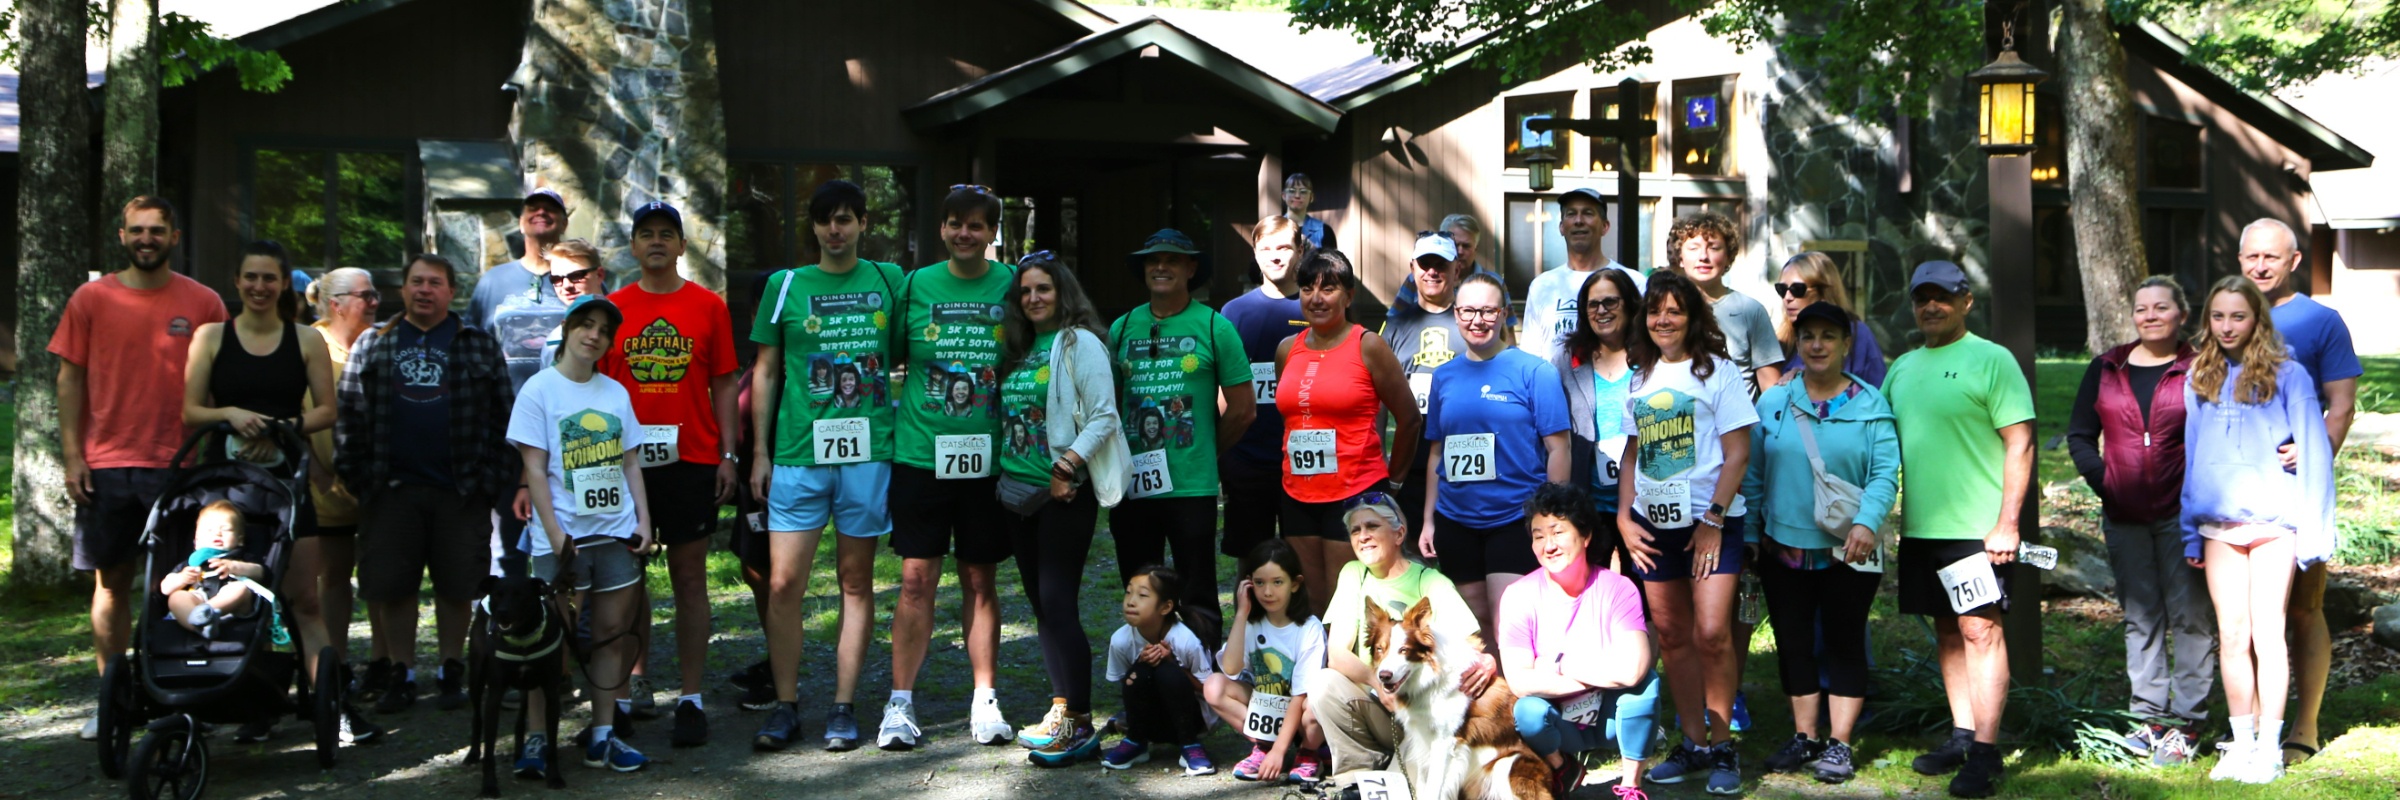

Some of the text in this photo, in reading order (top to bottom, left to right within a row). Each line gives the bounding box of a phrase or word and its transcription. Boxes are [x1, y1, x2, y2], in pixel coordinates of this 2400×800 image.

[815, 293, 863, 301] KOINONIA
[829, 315, 866, 325] 5K FOR
[851, 327, 877, 337] 50TH
[947, 326, 986, 335] 5K FOR
[624, 336, 693, 353] CRAFTHALF
[819, 340, 879, 351] BIRTHDAY!!
[968, 338, 996, 348] 50TH
[647, 356, 675, 365] MARATHON
[935, 351, 997, 361] BIRTHDAY!!
[1138, 359, 1173, 369] 5K FOR
[1157, 371, 1183, 380] 50TH
[1256, 380, 1277, 399] 75
[818, 422, 865, 433] CATSKILLS
[643, 430, 672, 439] SKILLS
[1290, 433, 1331, 444] CATSKILLS
[823, 437, 861, 459] 761
[940, 438, 986, 449] CATSKILLS
[1448, 439, 1490, 450] CATSKILLS
[1661, 441, 1673, 452] 5K
[945, 453, 982, 475] 760
[1293, 449, 1325, 469] 691
[1450, 454, 1486, 477] 729
[577, 471, 621, 483] CATSKILLS
[1131, 468, 1163, 494] 763
[1641, 485, 1685, 498] CATSKILLS
[584, 486, 620, 509] 696
[1647, 503, 1682, 523] 695
[1952, 577, 1988, 607] 750
